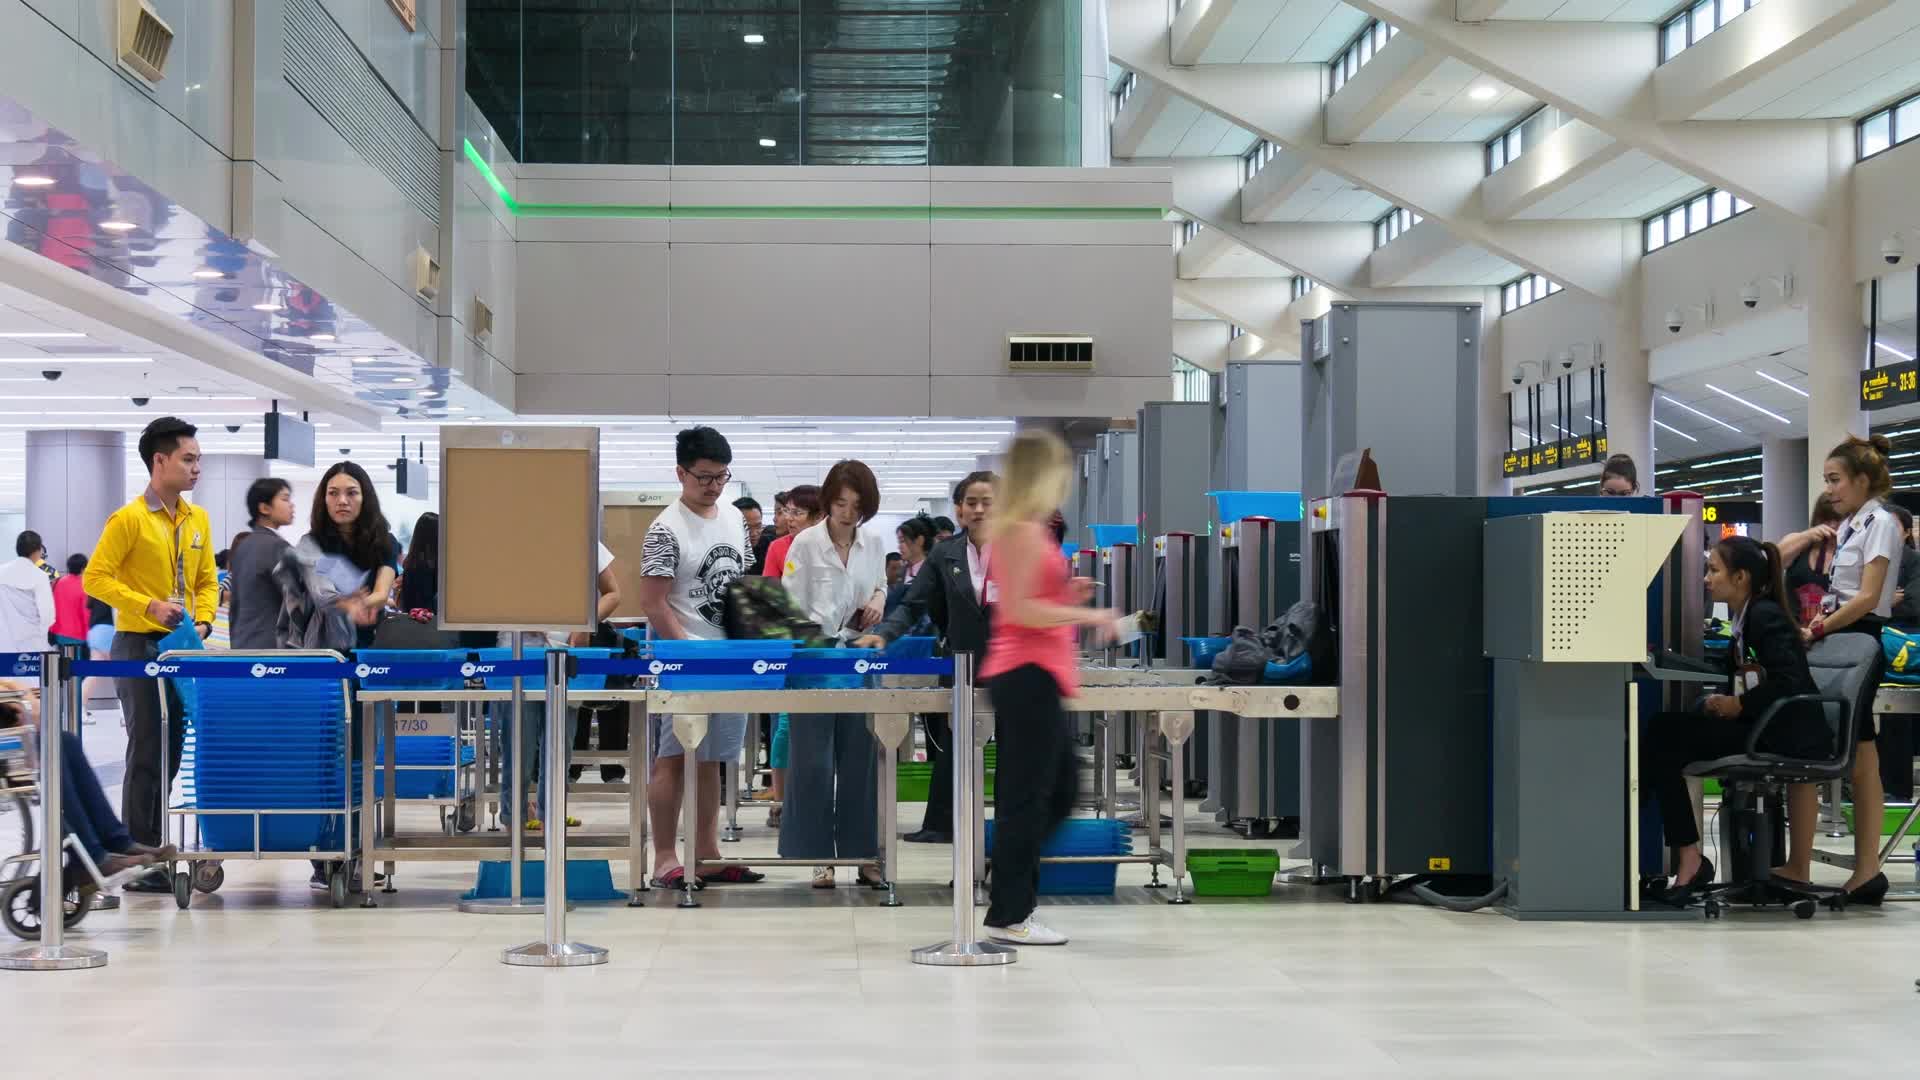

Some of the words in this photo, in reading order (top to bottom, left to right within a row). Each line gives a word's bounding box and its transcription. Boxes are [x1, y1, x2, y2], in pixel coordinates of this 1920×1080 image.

[160, 665, 180, 673] AOT
[266, 666, 286, 674] AOT
[476, 665, 495, 673] AOT
[664, 663, 683, 671] AOT
[768, 663, 788, 671] AOT
[869, 662, 888, 670] AOT
